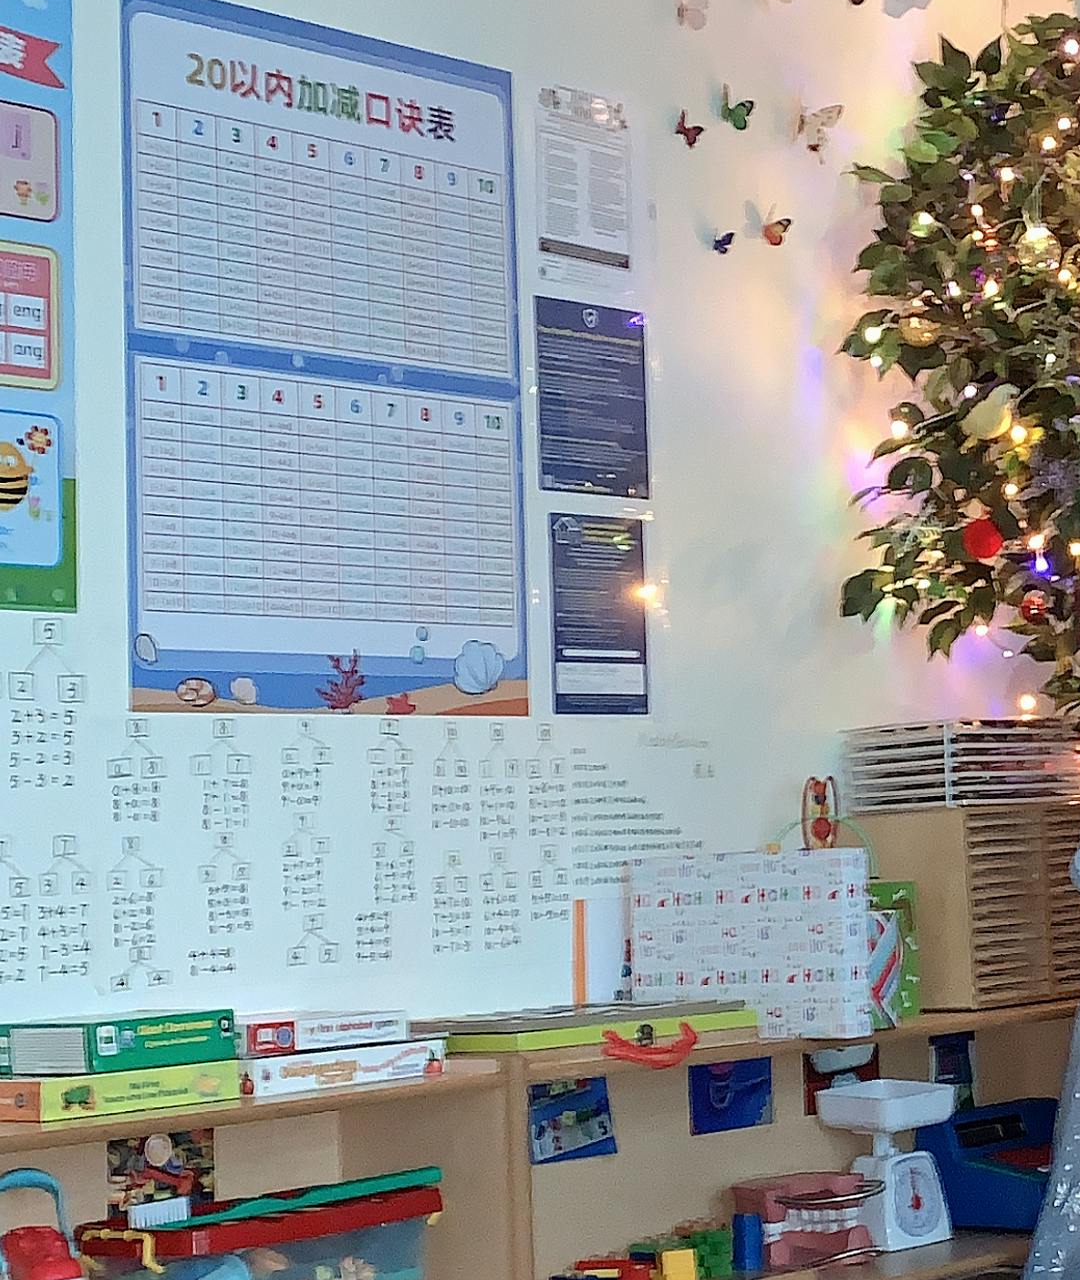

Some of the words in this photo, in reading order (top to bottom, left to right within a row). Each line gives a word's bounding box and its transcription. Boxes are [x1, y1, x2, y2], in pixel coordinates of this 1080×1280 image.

[152, 111, 162, 127] 1
[192, 120, 204, 135] 2
[231, 127, 241, 143] 3
[266, 135, 278, 151] 4
[307, 143, 318, 158] 5
[344, 151, 356, 165] 6
[379, 158, 391, 172] 7
[414, 165, 424, 180] 8
[447, 172, 457, 186] 9
[477, 178, 495, 194] 10
[13, 304, 42, 323] eng
[13, 343, 42, 363] ang
[155, 376, 167, 391] 1
[197, 380, 209, 396] 2
[237, 385, 248, 400] 3
[272, 389, 284, 405] 4
[313, 394, 324, 409] 5
[350, 399, 362, 414] 6
[387, 403, 397, 417] 7
[420, 407, 432, 422] 8
[454, 411, 465, 425] 9
[484, 414, 503, 430] 10
